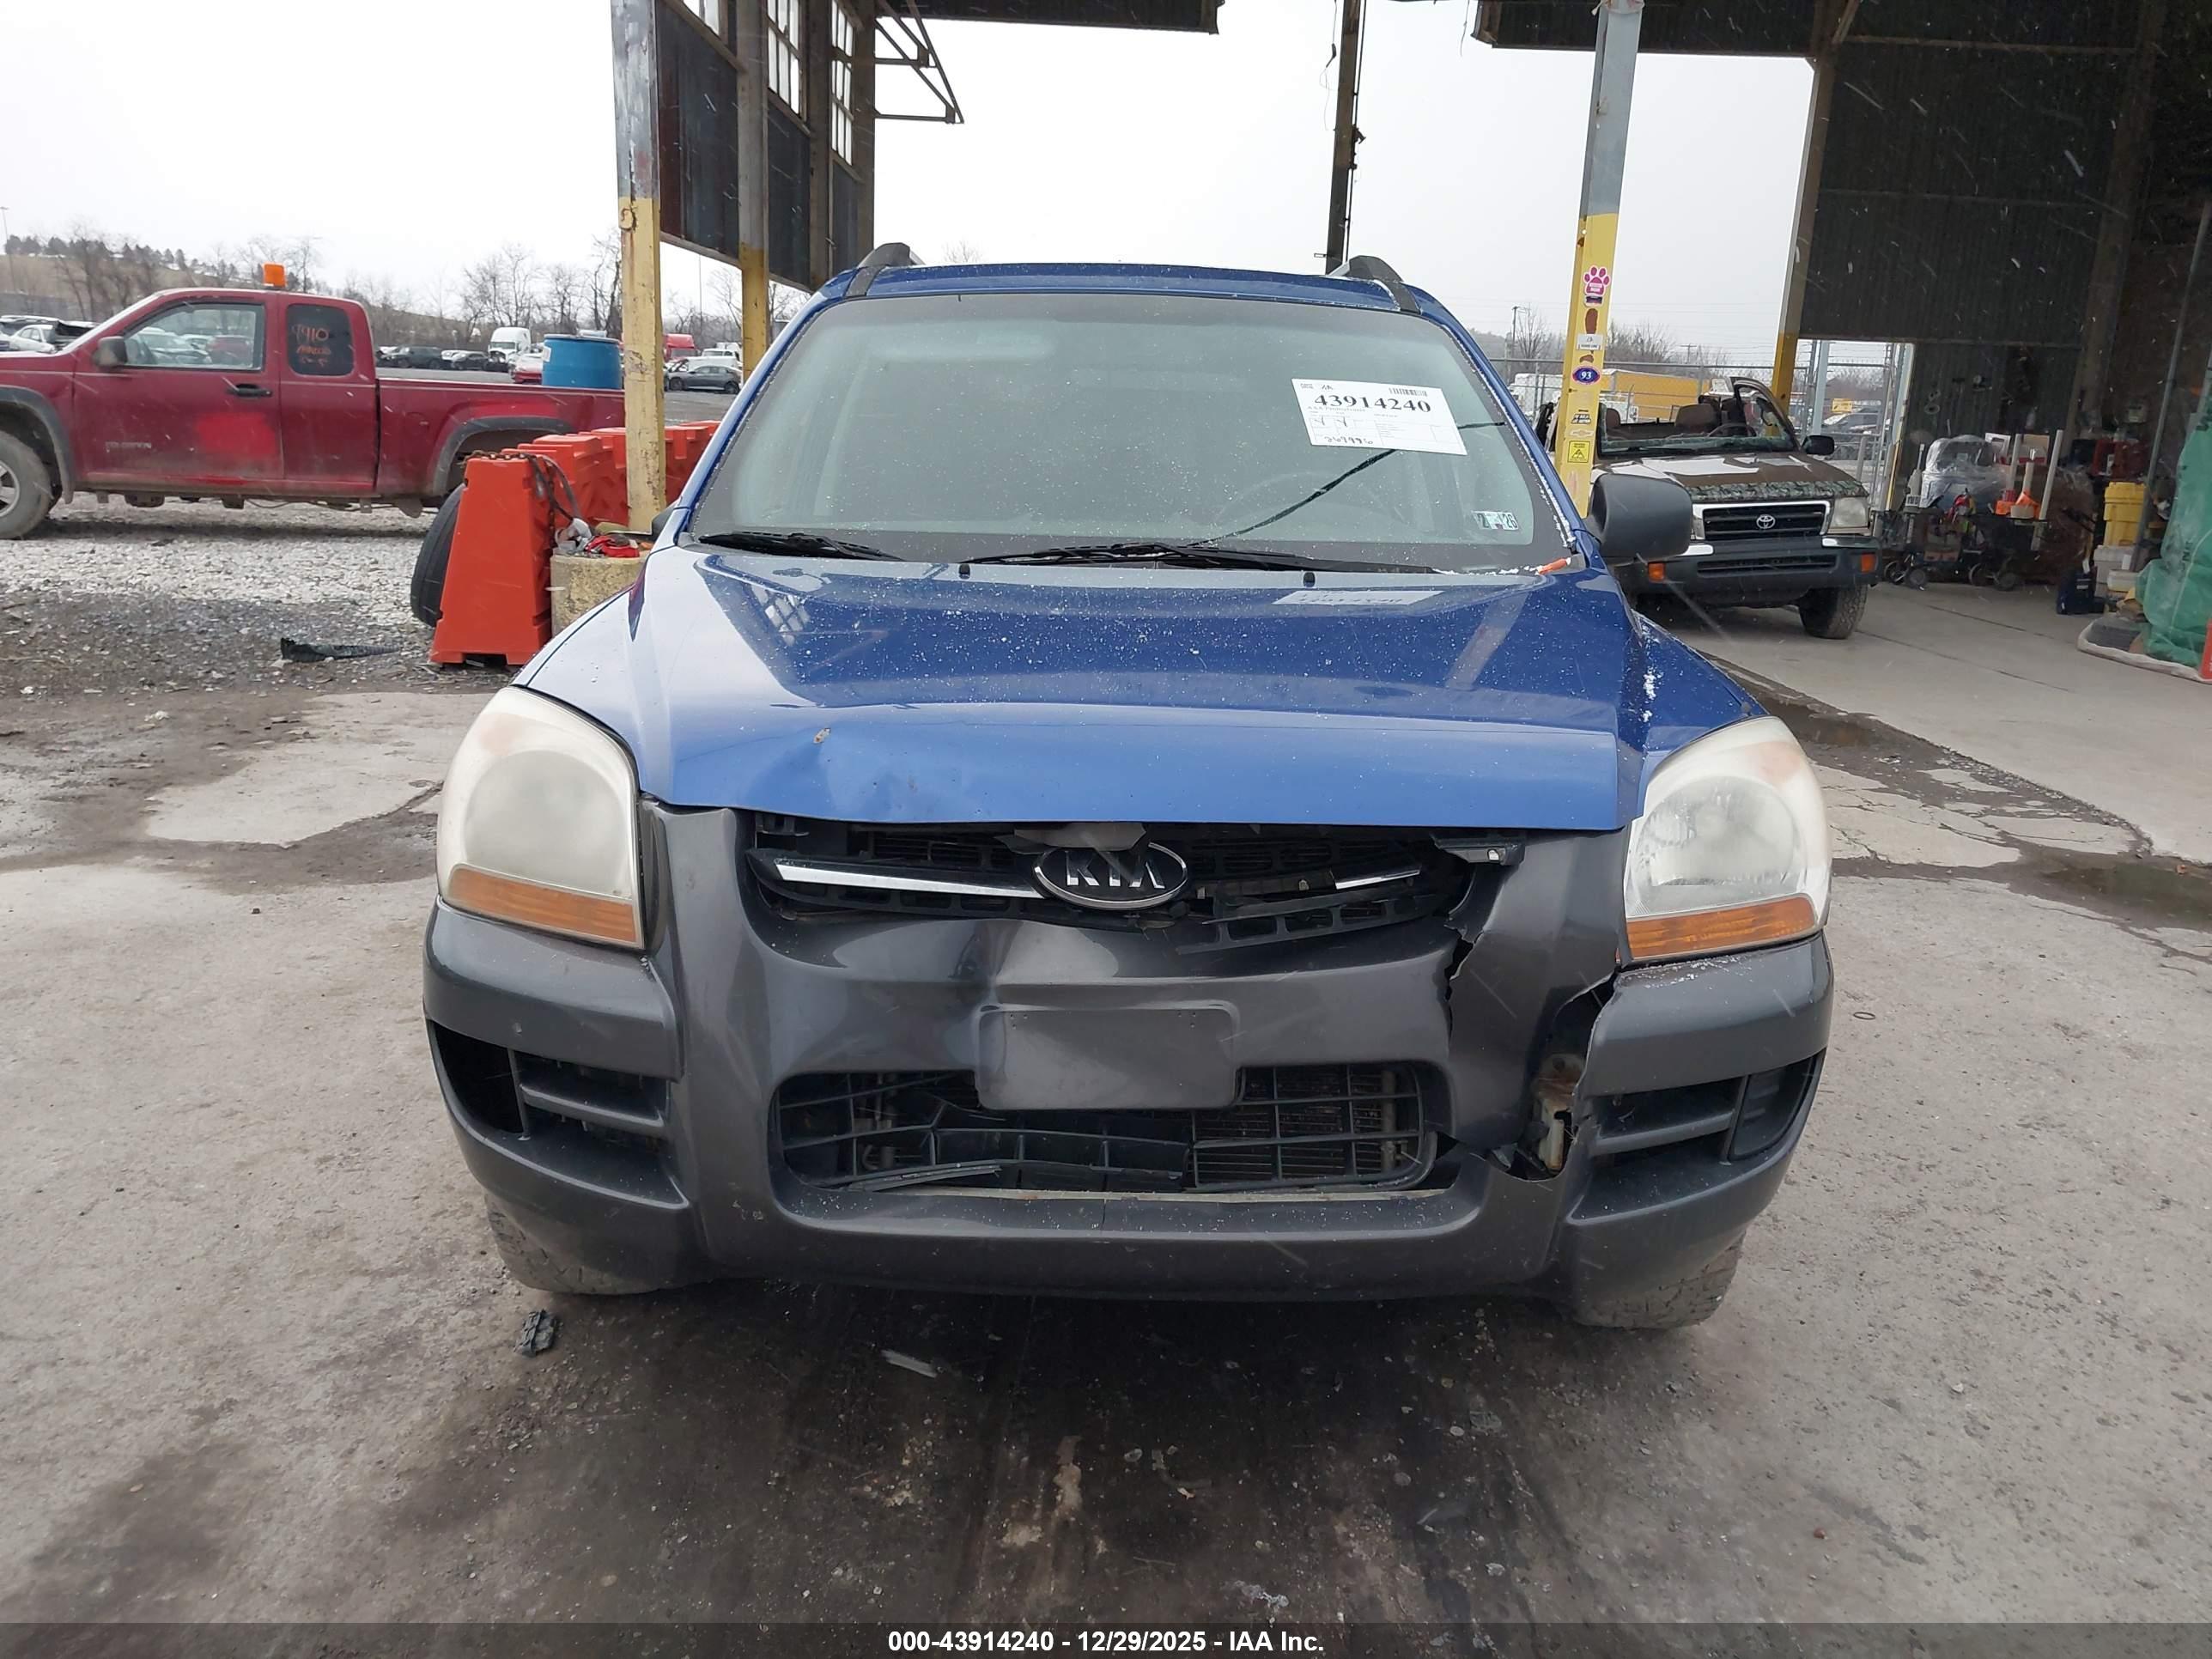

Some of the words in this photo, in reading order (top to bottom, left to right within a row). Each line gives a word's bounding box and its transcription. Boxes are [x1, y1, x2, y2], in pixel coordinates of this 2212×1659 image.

[1580, 370, 1592, 380] 93
[1314, 394, 1431, 413] 43914240
[1065, 851, 1166, 890] KIA
